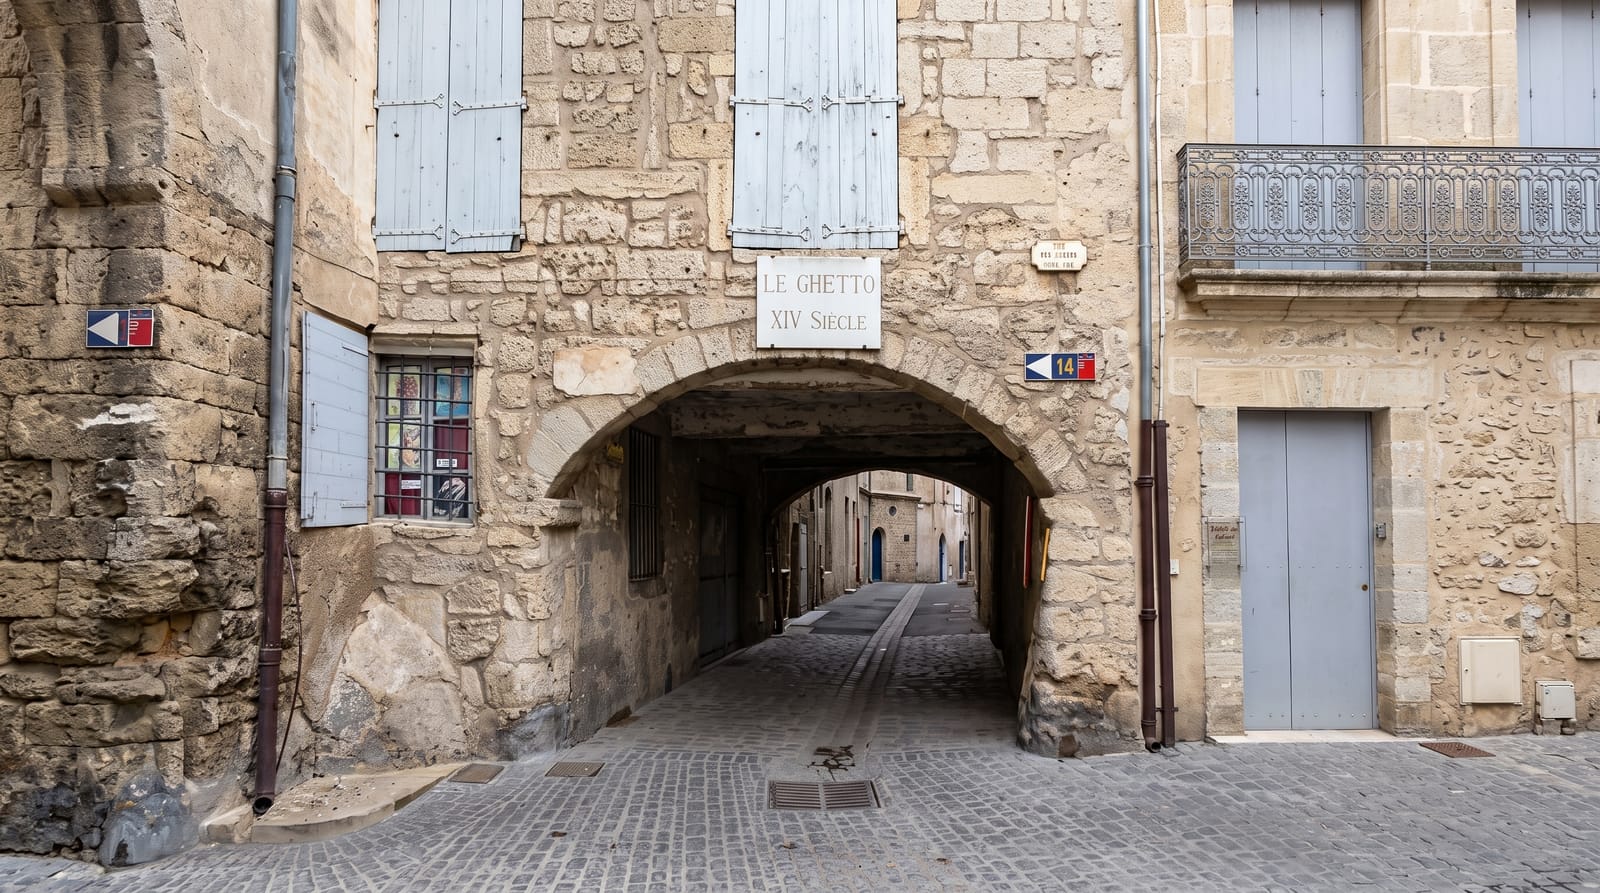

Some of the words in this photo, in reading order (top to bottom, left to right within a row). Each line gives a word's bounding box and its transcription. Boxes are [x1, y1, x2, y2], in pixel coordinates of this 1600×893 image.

[763, 274, 787, 293] LE
[796, 274, 875, 294] GHETTO
[770, 310, 802, 330] XIV
[1056, 357, 1075, 376] 14
